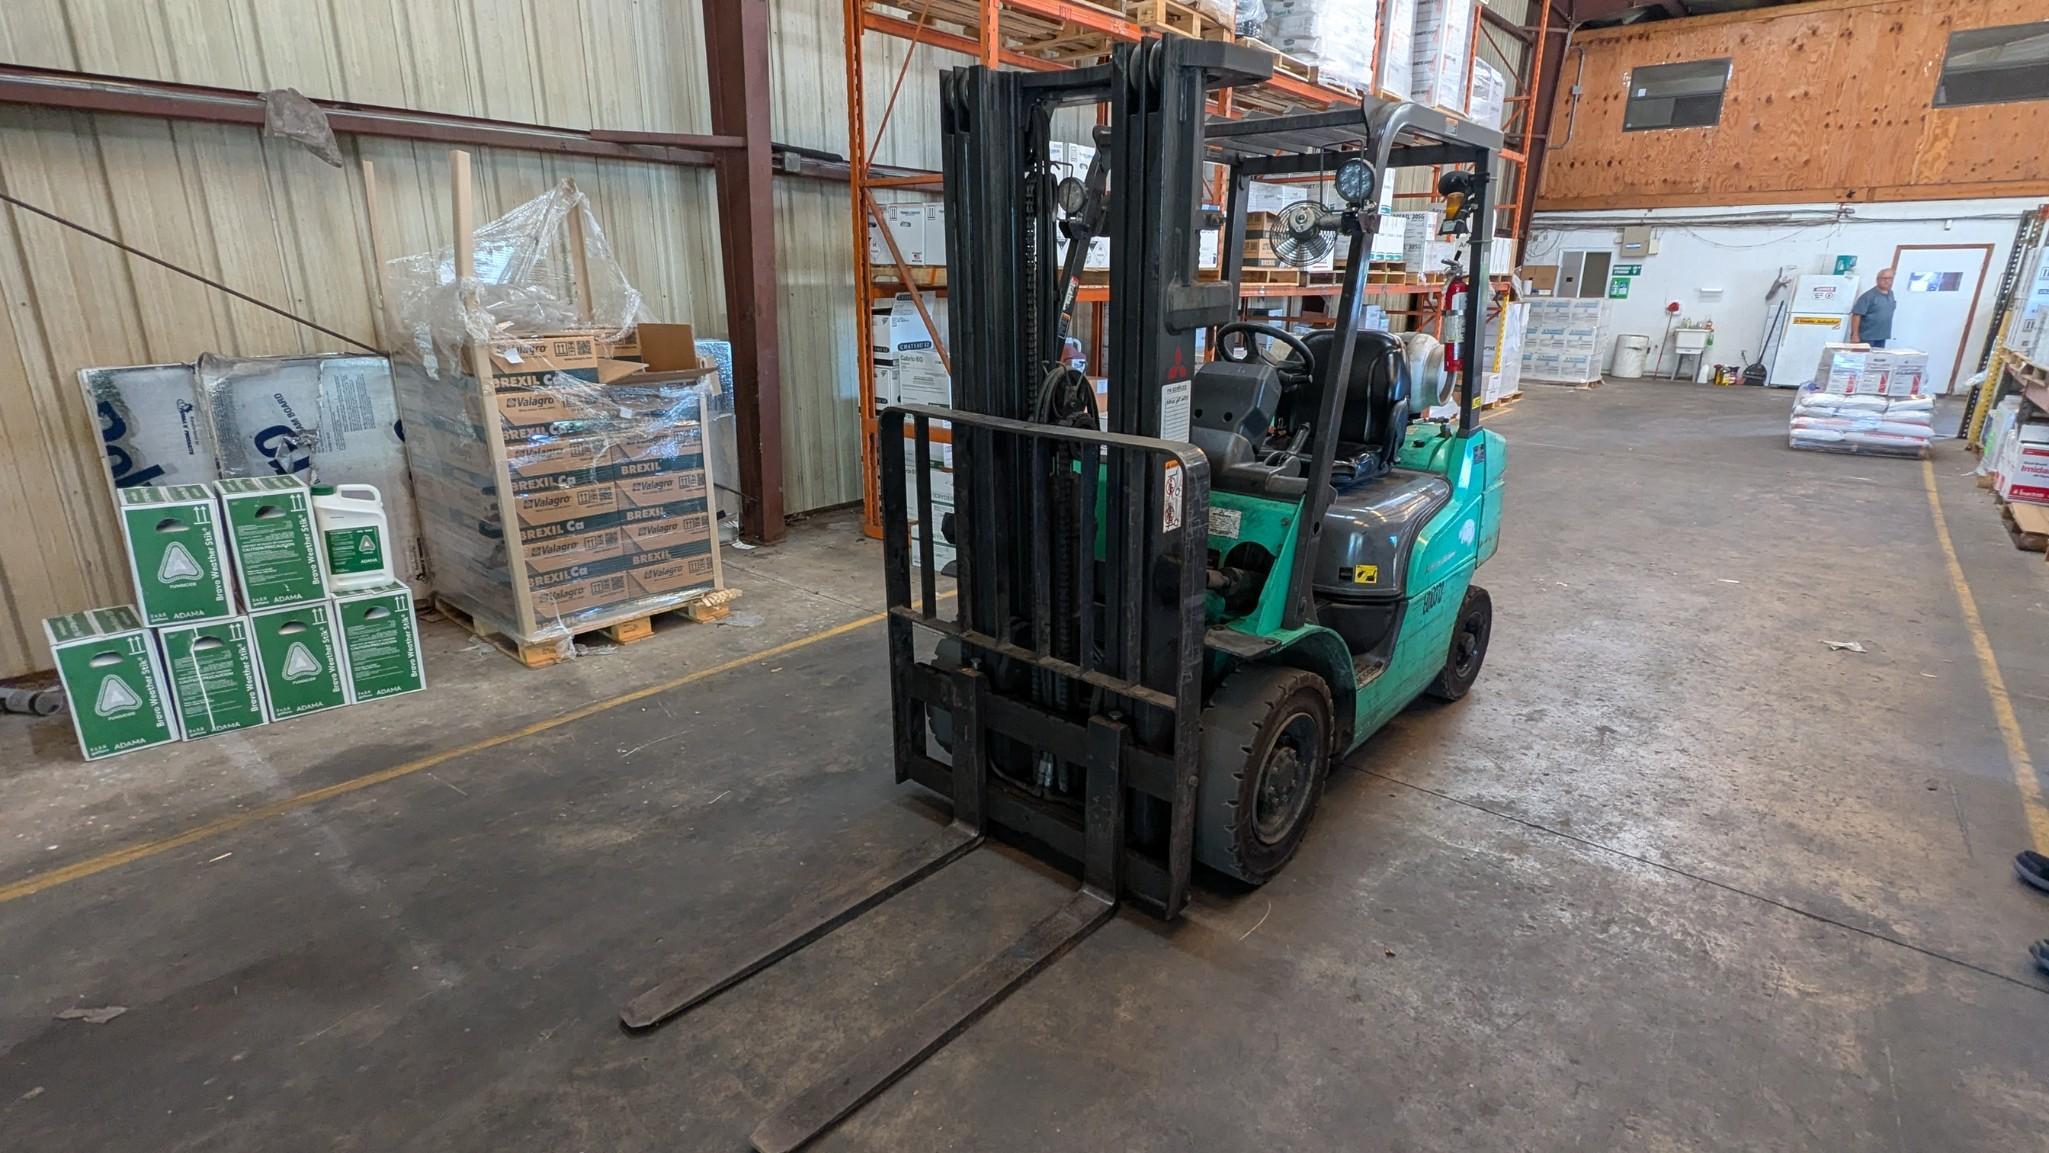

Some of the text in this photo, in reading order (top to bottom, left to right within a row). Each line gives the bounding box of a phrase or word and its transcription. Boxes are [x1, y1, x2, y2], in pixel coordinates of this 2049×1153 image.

[274, 393, 296, 418] BOARD
[517, 396, 554, 408] Valagro
[621, 462, 662, 475] BREXIL
[558, 475, 576, 487] Ca
[641, 479, 673, 490] Valagro
[534, 495, 571, 508] Valagro
[520, 520, 585, 540] BREXIL Ca
[646, 523, 678, 535] Valagro
[303, 534, 315, 564] Weather
[633, 550, 672, 565] BREXIL
[207, 547, 219, 579] Weather
[570, 566, 588, 577] Ca
[311, 564, 320, 585] Bravo
[215, 580, 224, 601] Bravo
[273, 594, 303, 603] ADAMA
[173, 610, 205, 619] ADAMA
[405, 630, 415, 659] Weather
[324, 644, 337, 673] Weather
[242, 662, 255, 692] Weather
[410, 659, 418, 678] Bravo
[145, 675, 158, 707] Weather
[332, 673, 340, 693] Bravo
[376, 686, 402, 695] ADAMA
[250, 692, 259, 712] Bravo
[296, 701, 324, 712] ADAMA
[153, 707, 165, 727] Bravo
[211, 721, 241, 732] ADAMA
[114, 737, 147, 750] ADAMA
